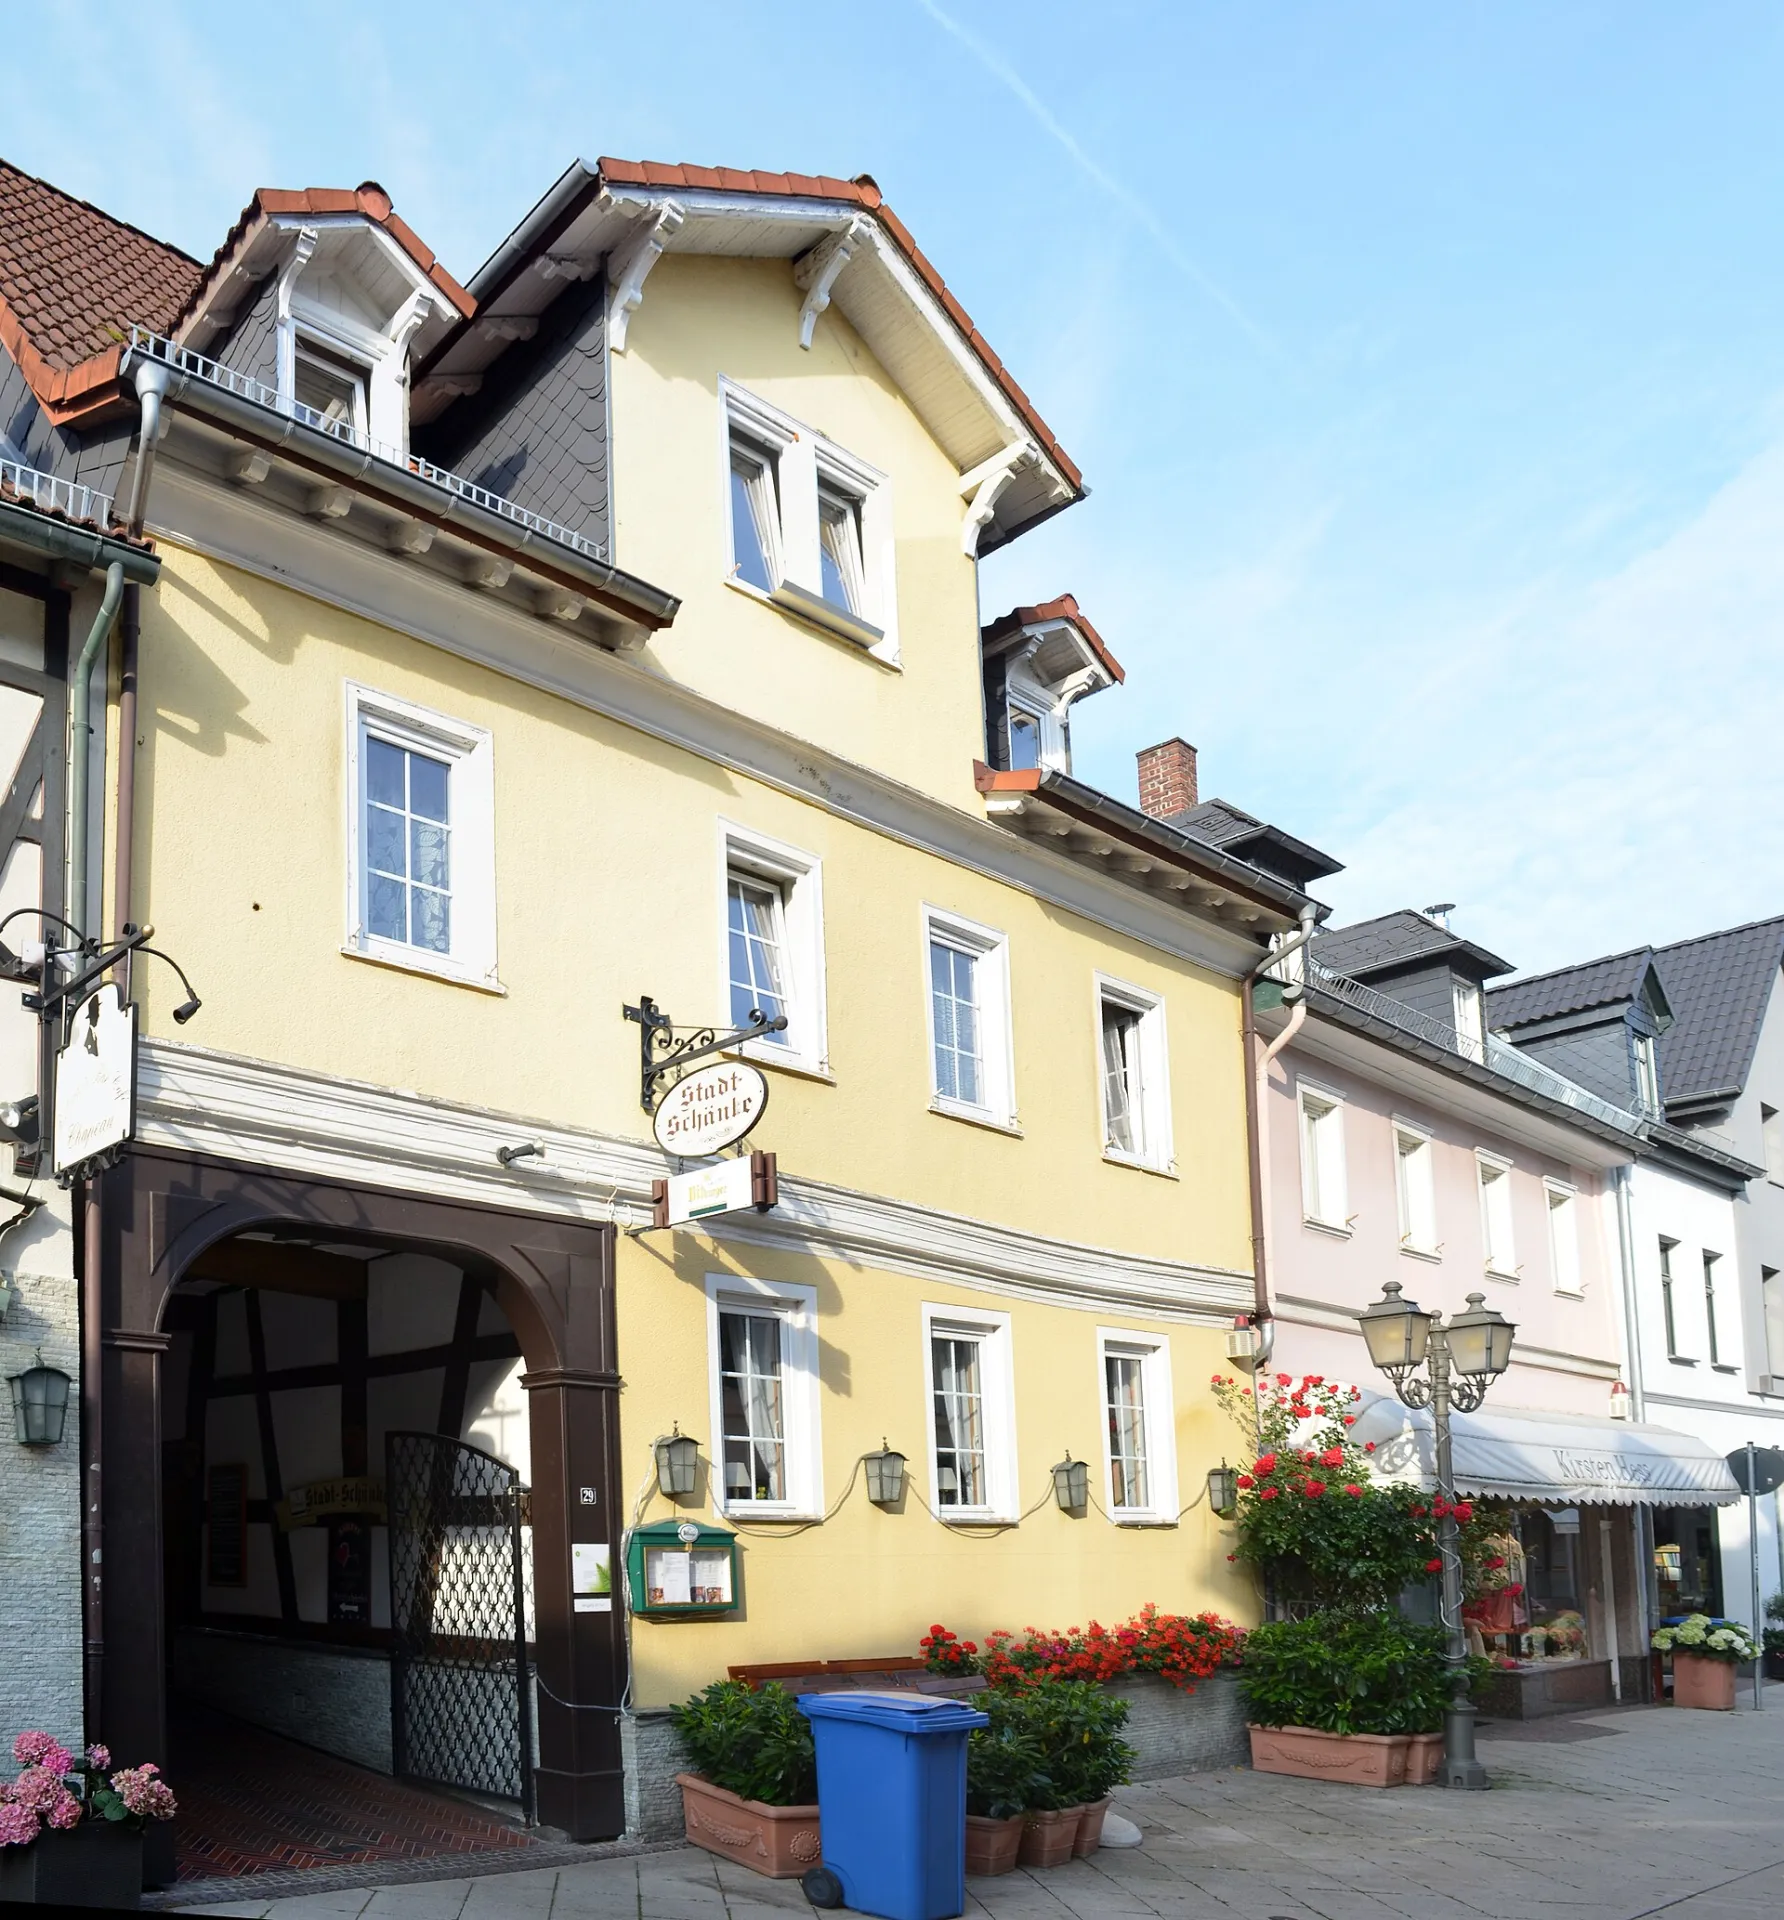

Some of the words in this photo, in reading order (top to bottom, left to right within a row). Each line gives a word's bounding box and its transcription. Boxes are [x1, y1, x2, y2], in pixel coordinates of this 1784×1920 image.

[666, 1097, 752, 1141] Schänke
[1552, 1449, 1615, 1480] Kirsten
[1613, 1454, 1652, 1483] Hess
[582, 1489, 594, 1503] 29
